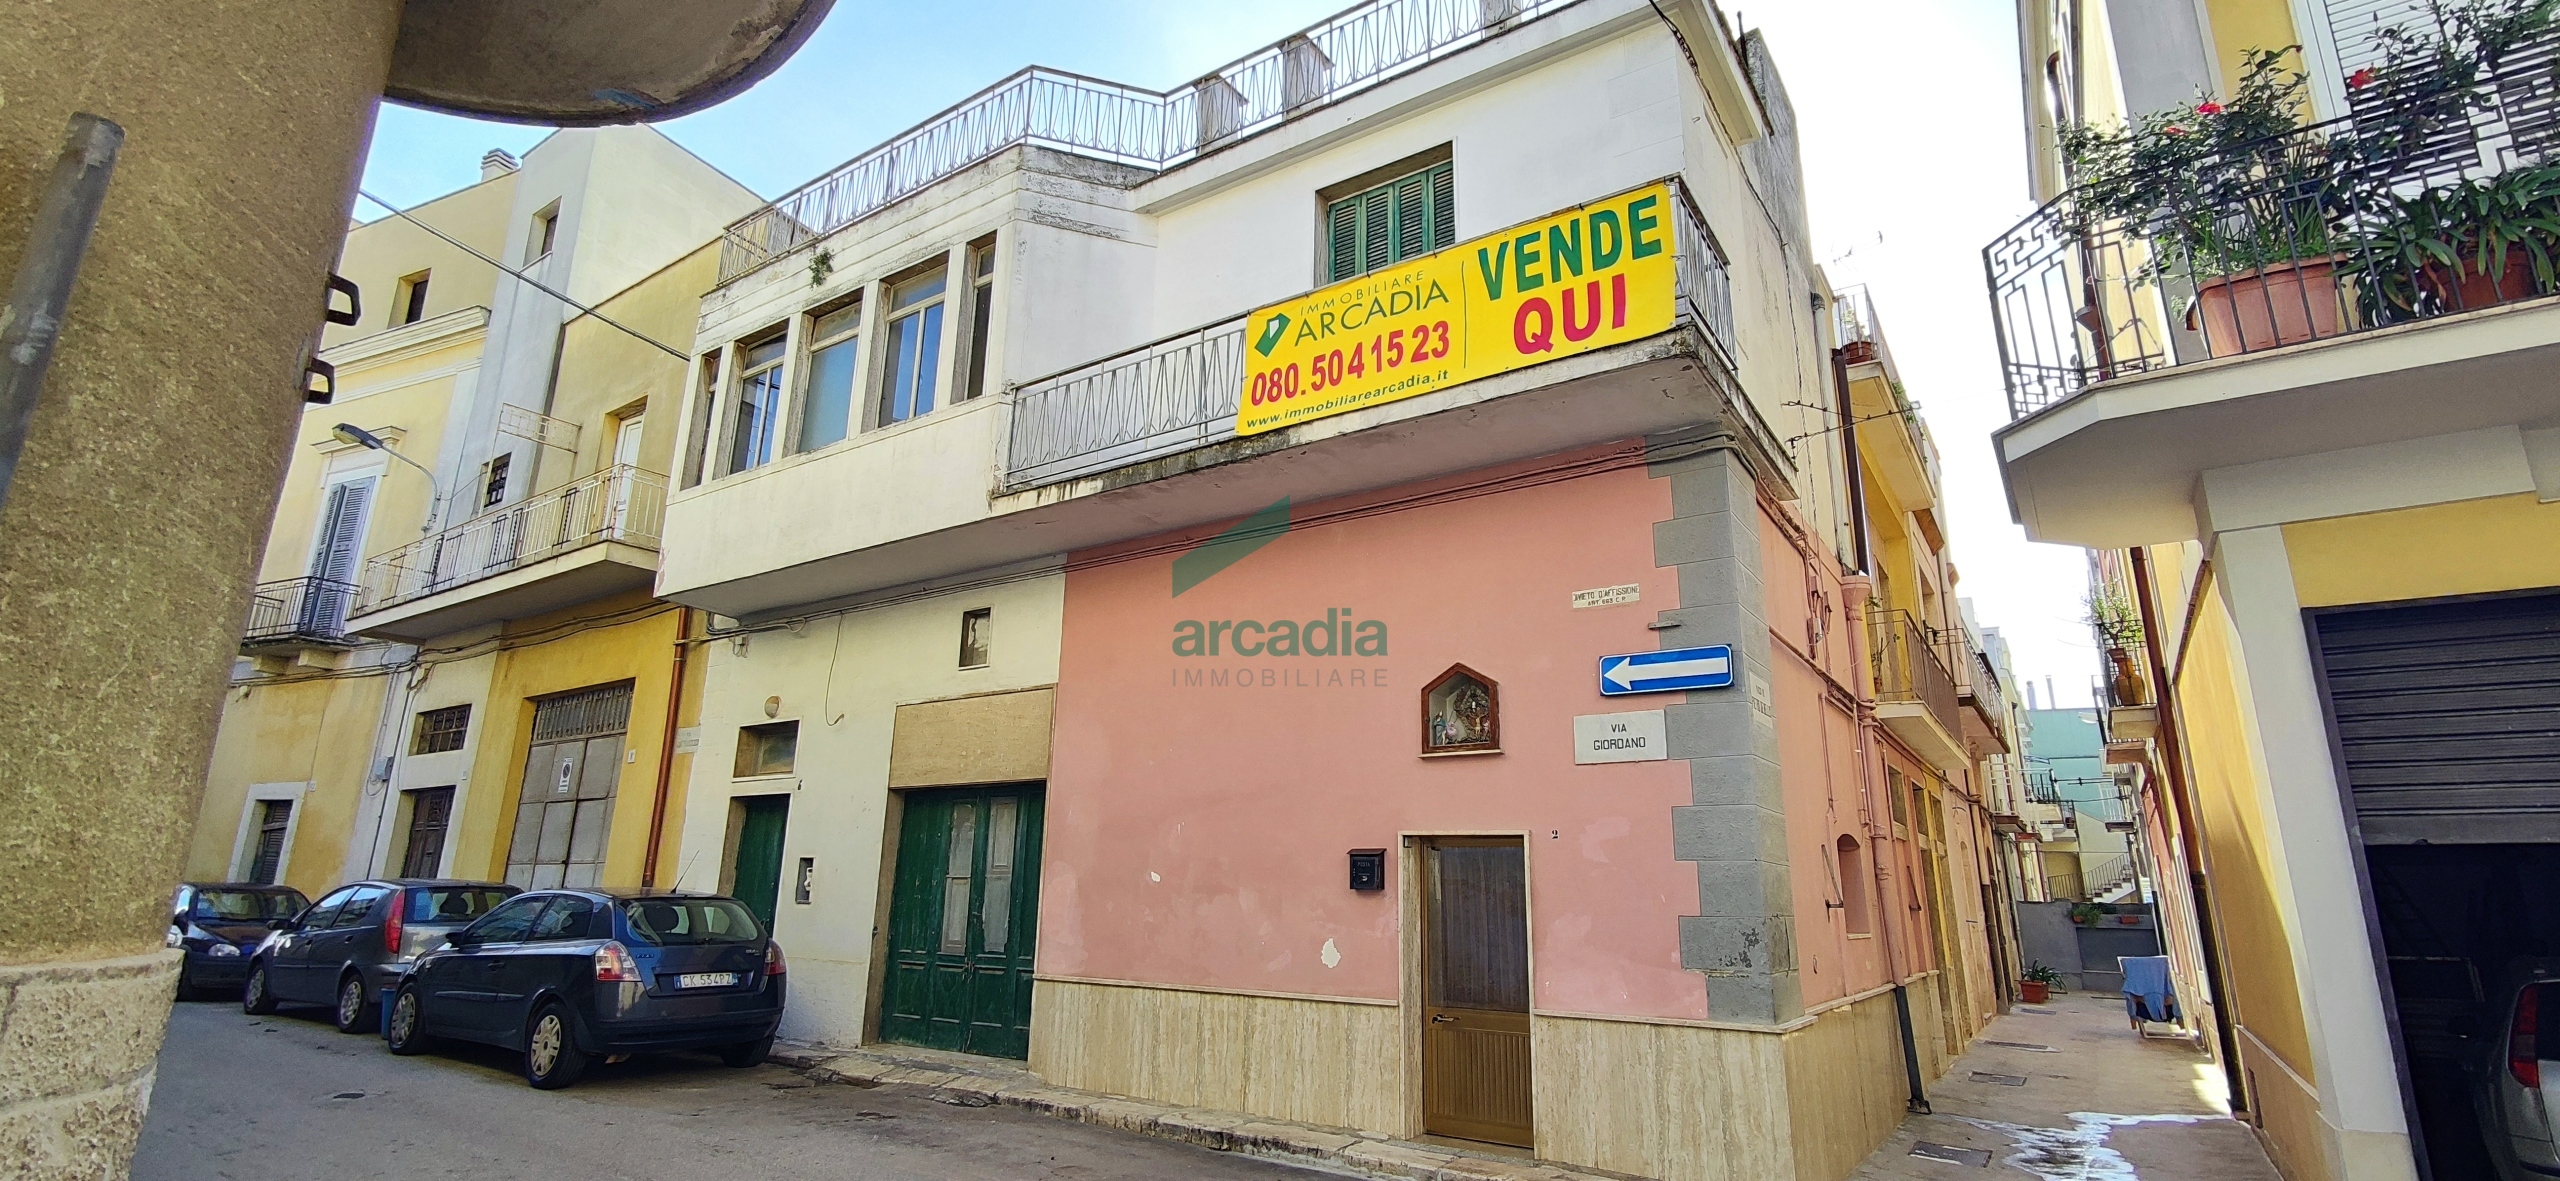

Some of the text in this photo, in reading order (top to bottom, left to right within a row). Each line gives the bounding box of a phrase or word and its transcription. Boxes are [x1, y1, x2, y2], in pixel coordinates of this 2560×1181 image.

[1478, 194, 1662, 301] VENDE
[1294, 279, 1450, 347] ARCADIA
[1300, 270, 1424, 316] IMMOBILIARE
[1514, 273, 1627, 354] QUI
[1246, 370, 1449, 428] www.immobiliarearcadia.it
[1593, 736, 1646, 751] GIORDANO
[1611, 723, 1627, 733] VIA
[683, 975, 697, 987] CK
